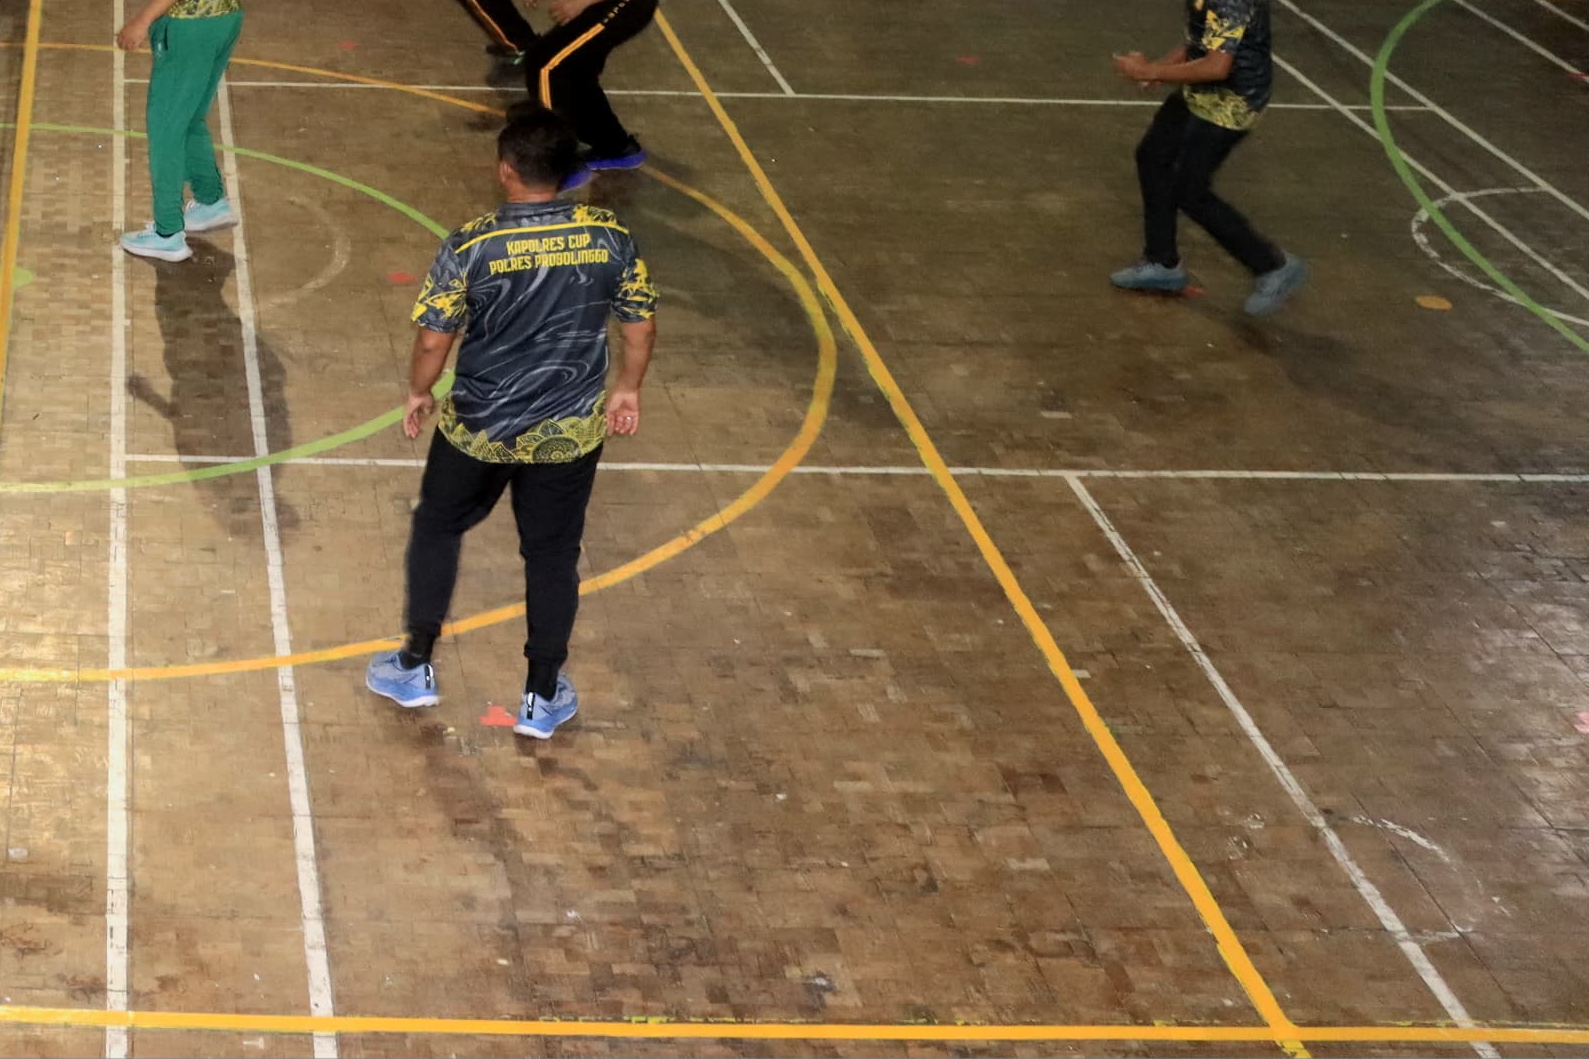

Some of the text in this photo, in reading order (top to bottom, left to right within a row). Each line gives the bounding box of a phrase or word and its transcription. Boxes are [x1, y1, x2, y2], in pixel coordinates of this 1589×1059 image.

[506, 233, 591, 255] KAPOLRES CUP
[489, 248, 609, 275] POLRES PROBOLINGGO
